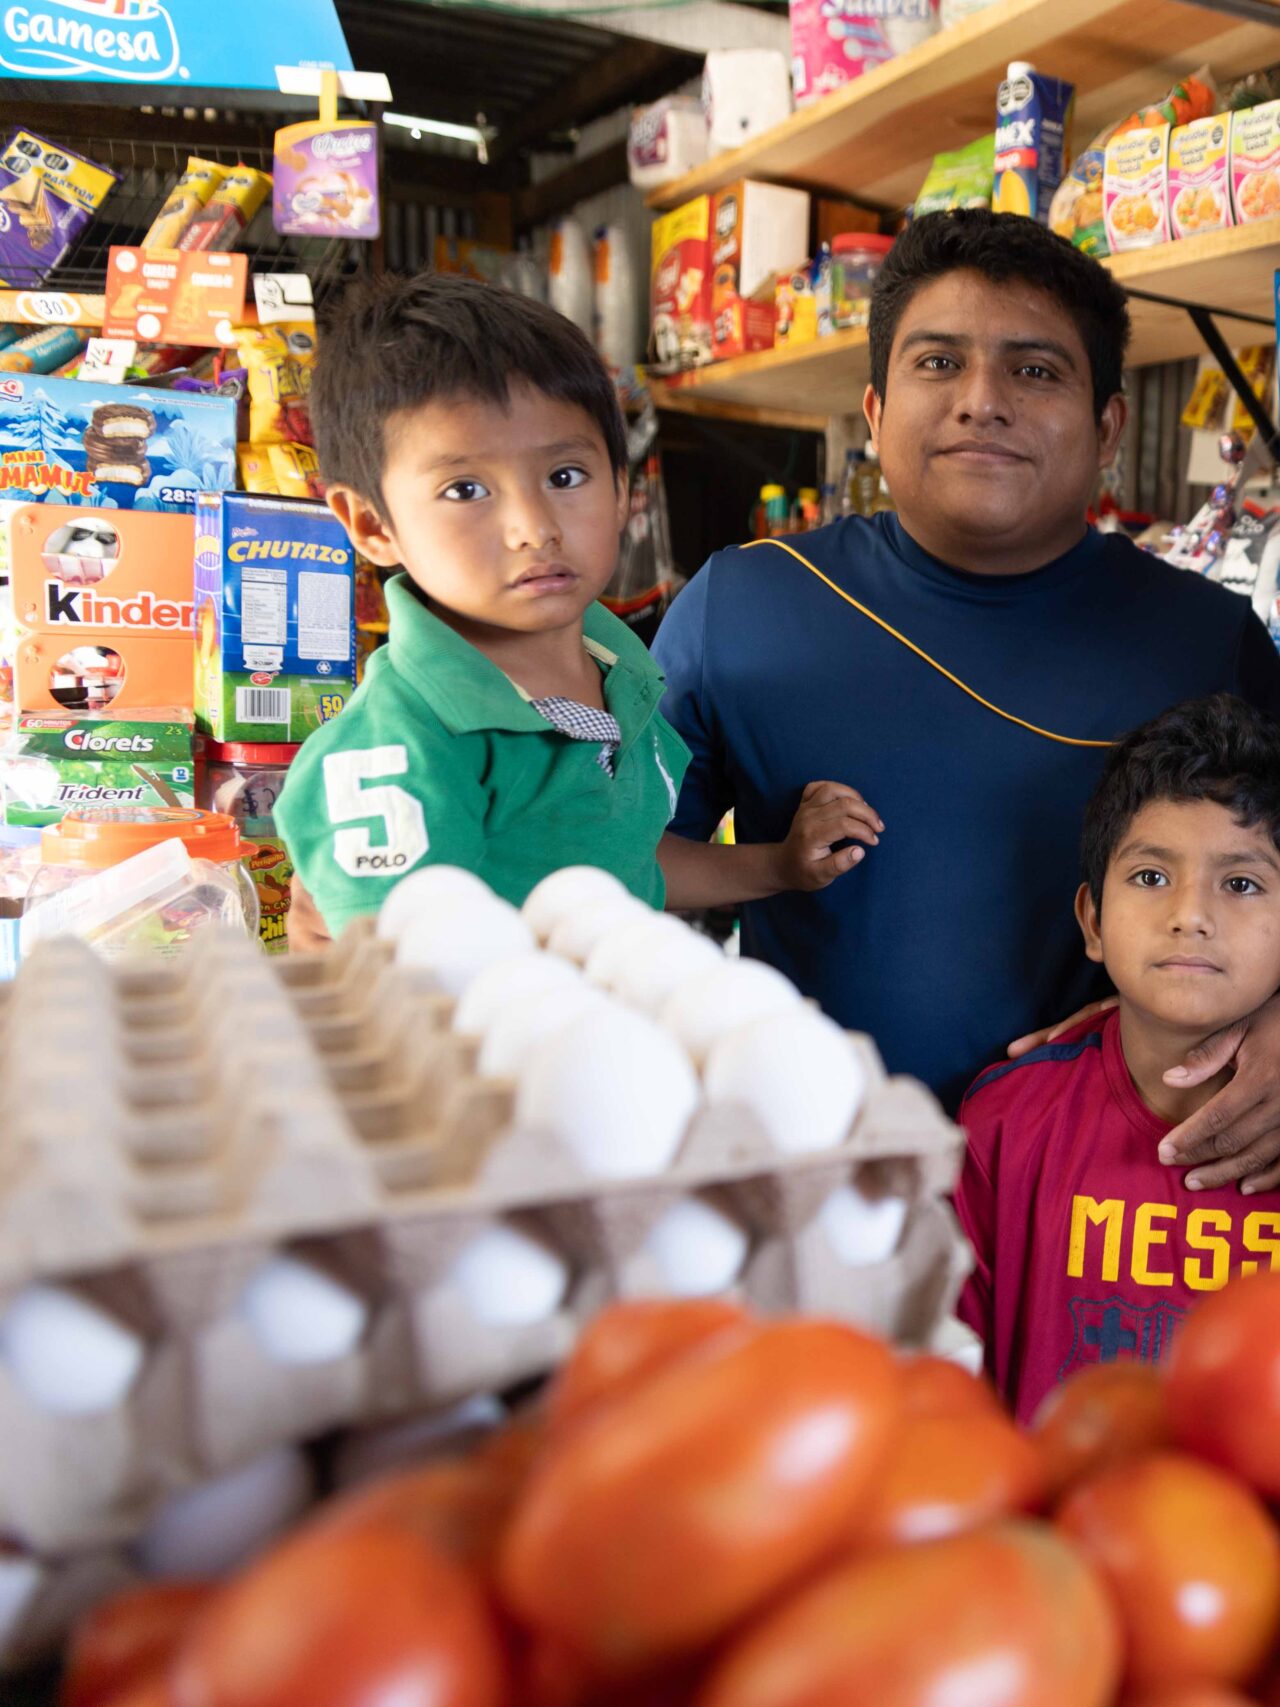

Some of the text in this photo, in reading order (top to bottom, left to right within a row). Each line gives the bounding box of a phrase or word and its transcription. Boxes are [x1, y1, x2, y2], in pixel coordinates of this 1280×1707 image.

[4, 6, 161, 61] Gamesa
[3, 450, 46, 464] MINI
[162, 488, 185, 503] 28
[227, 540, 349, 565] CHUTAZO
[322, 695, 343, 713] 50
[26, 719, 43, 728] 60
[165, 726, 183, 735] 2's
[64, 729, 154, 752] Clorets
[58, 784, 145, 801] Trident
[323, 744, 430, 877] 5
[356, 853, 407, 869] POLO
